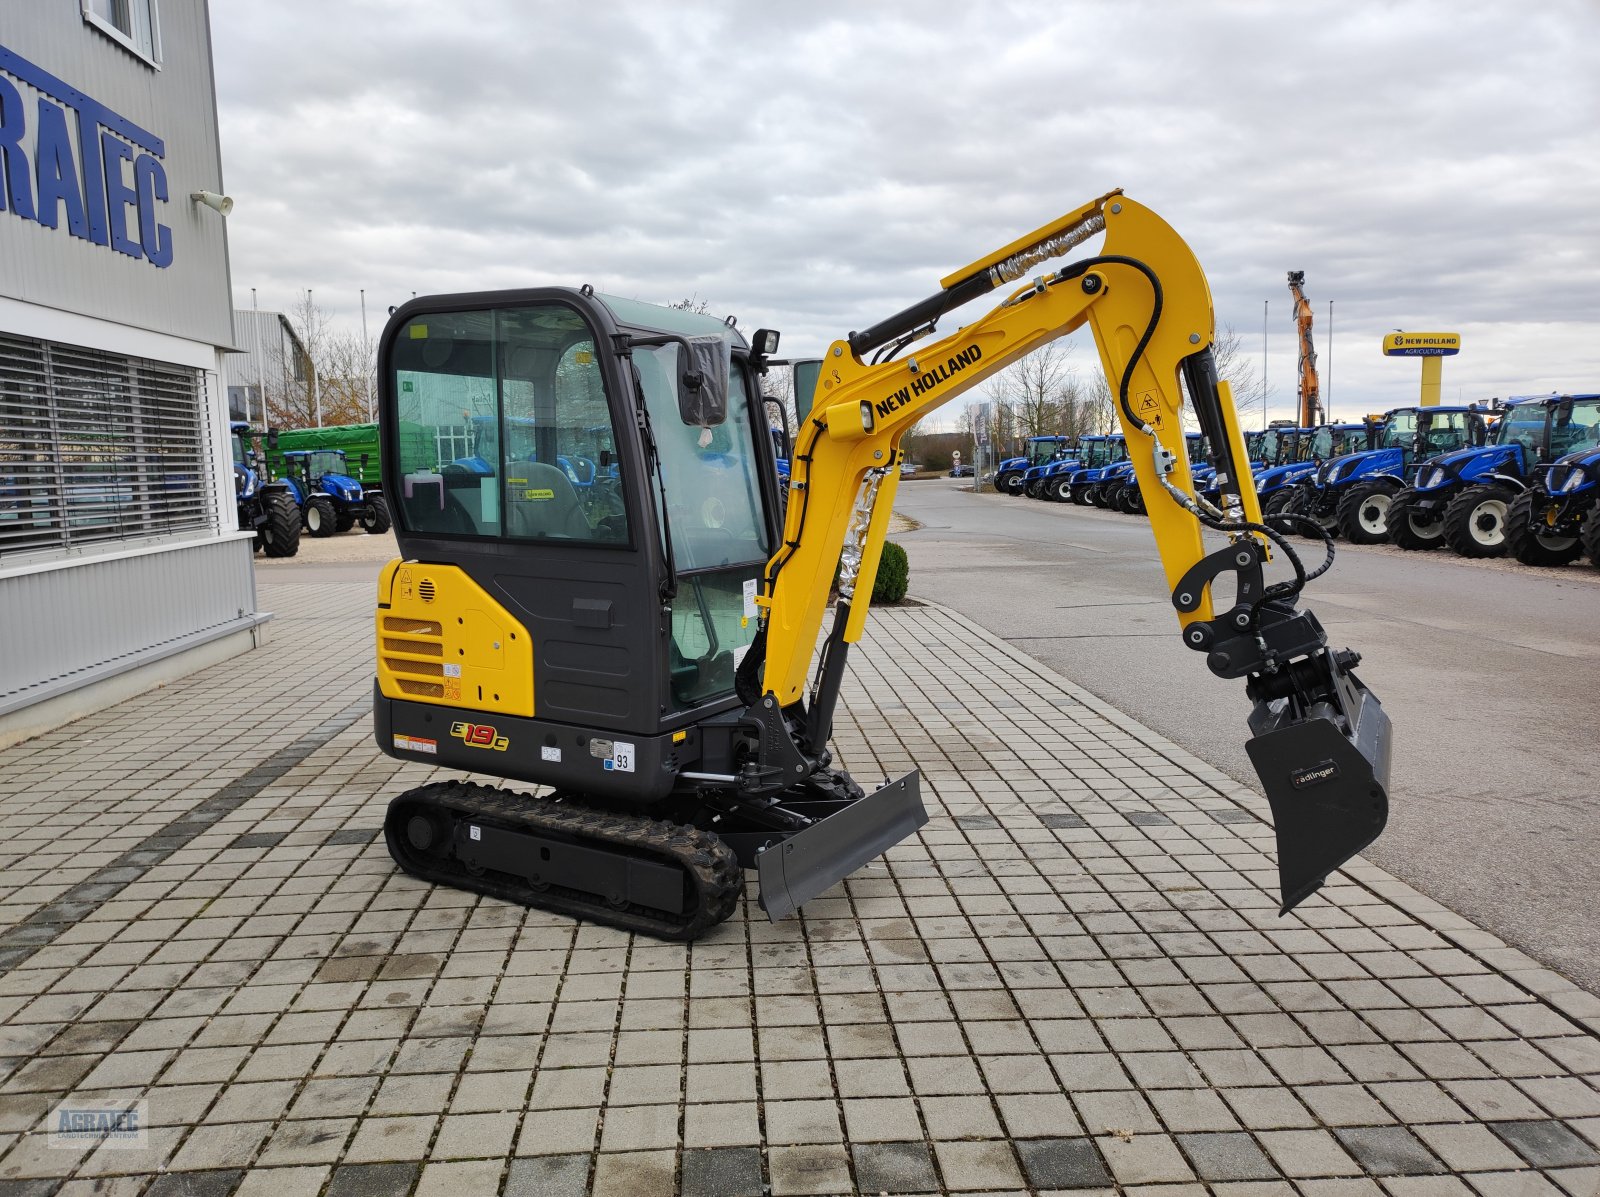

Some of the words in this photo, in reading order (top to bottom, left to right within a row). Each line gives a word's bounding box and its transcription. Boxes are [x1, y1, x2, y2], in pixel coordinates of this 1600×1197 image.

[875, 386, 912, 419] NEW
[910, 344, 982, 398] HOLLAND
[451, 722, 508, 749] E19C
[616, 754, 628, 769] 93
